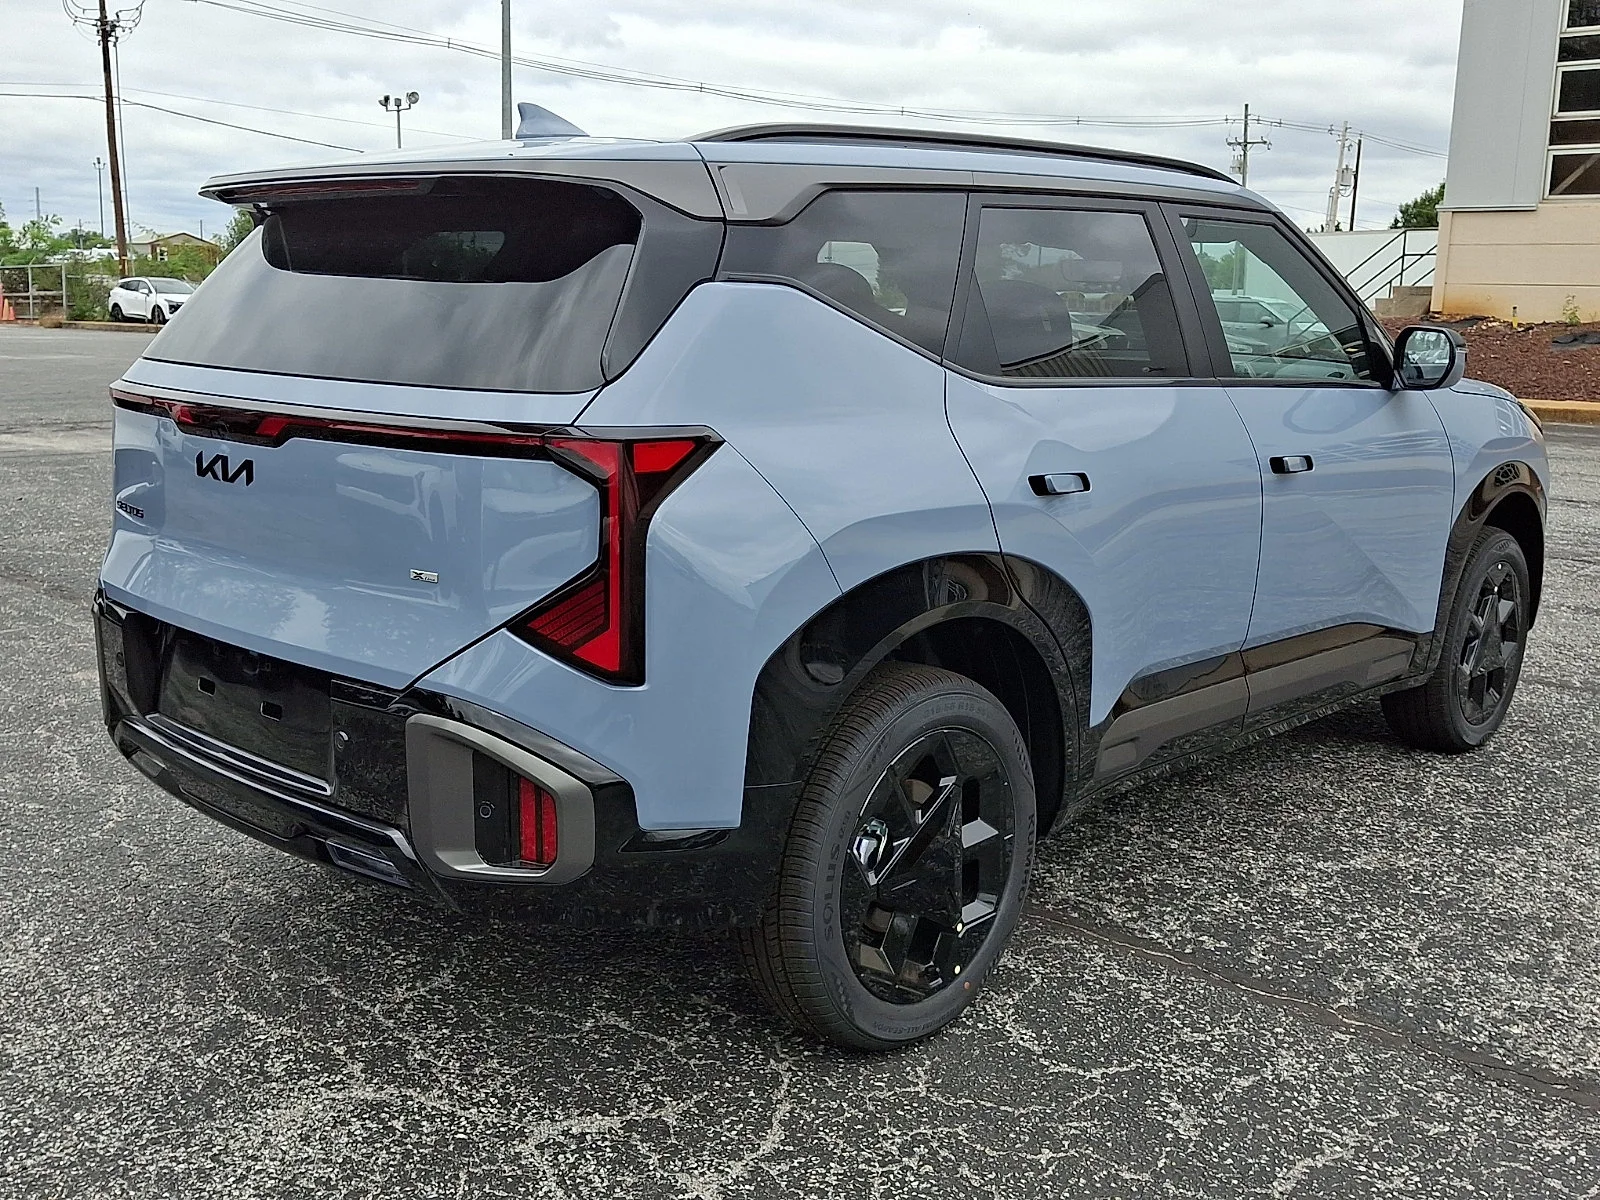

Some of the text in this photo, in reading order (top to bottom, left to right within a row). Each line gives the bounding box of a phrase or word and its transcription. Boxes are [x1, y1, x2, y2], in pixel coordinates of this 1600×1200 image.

[195, 450, 254, 487] KIA
[822, 842, 841, 943] SOLUS
[1017, 812, 1036, 902] KUMHO
